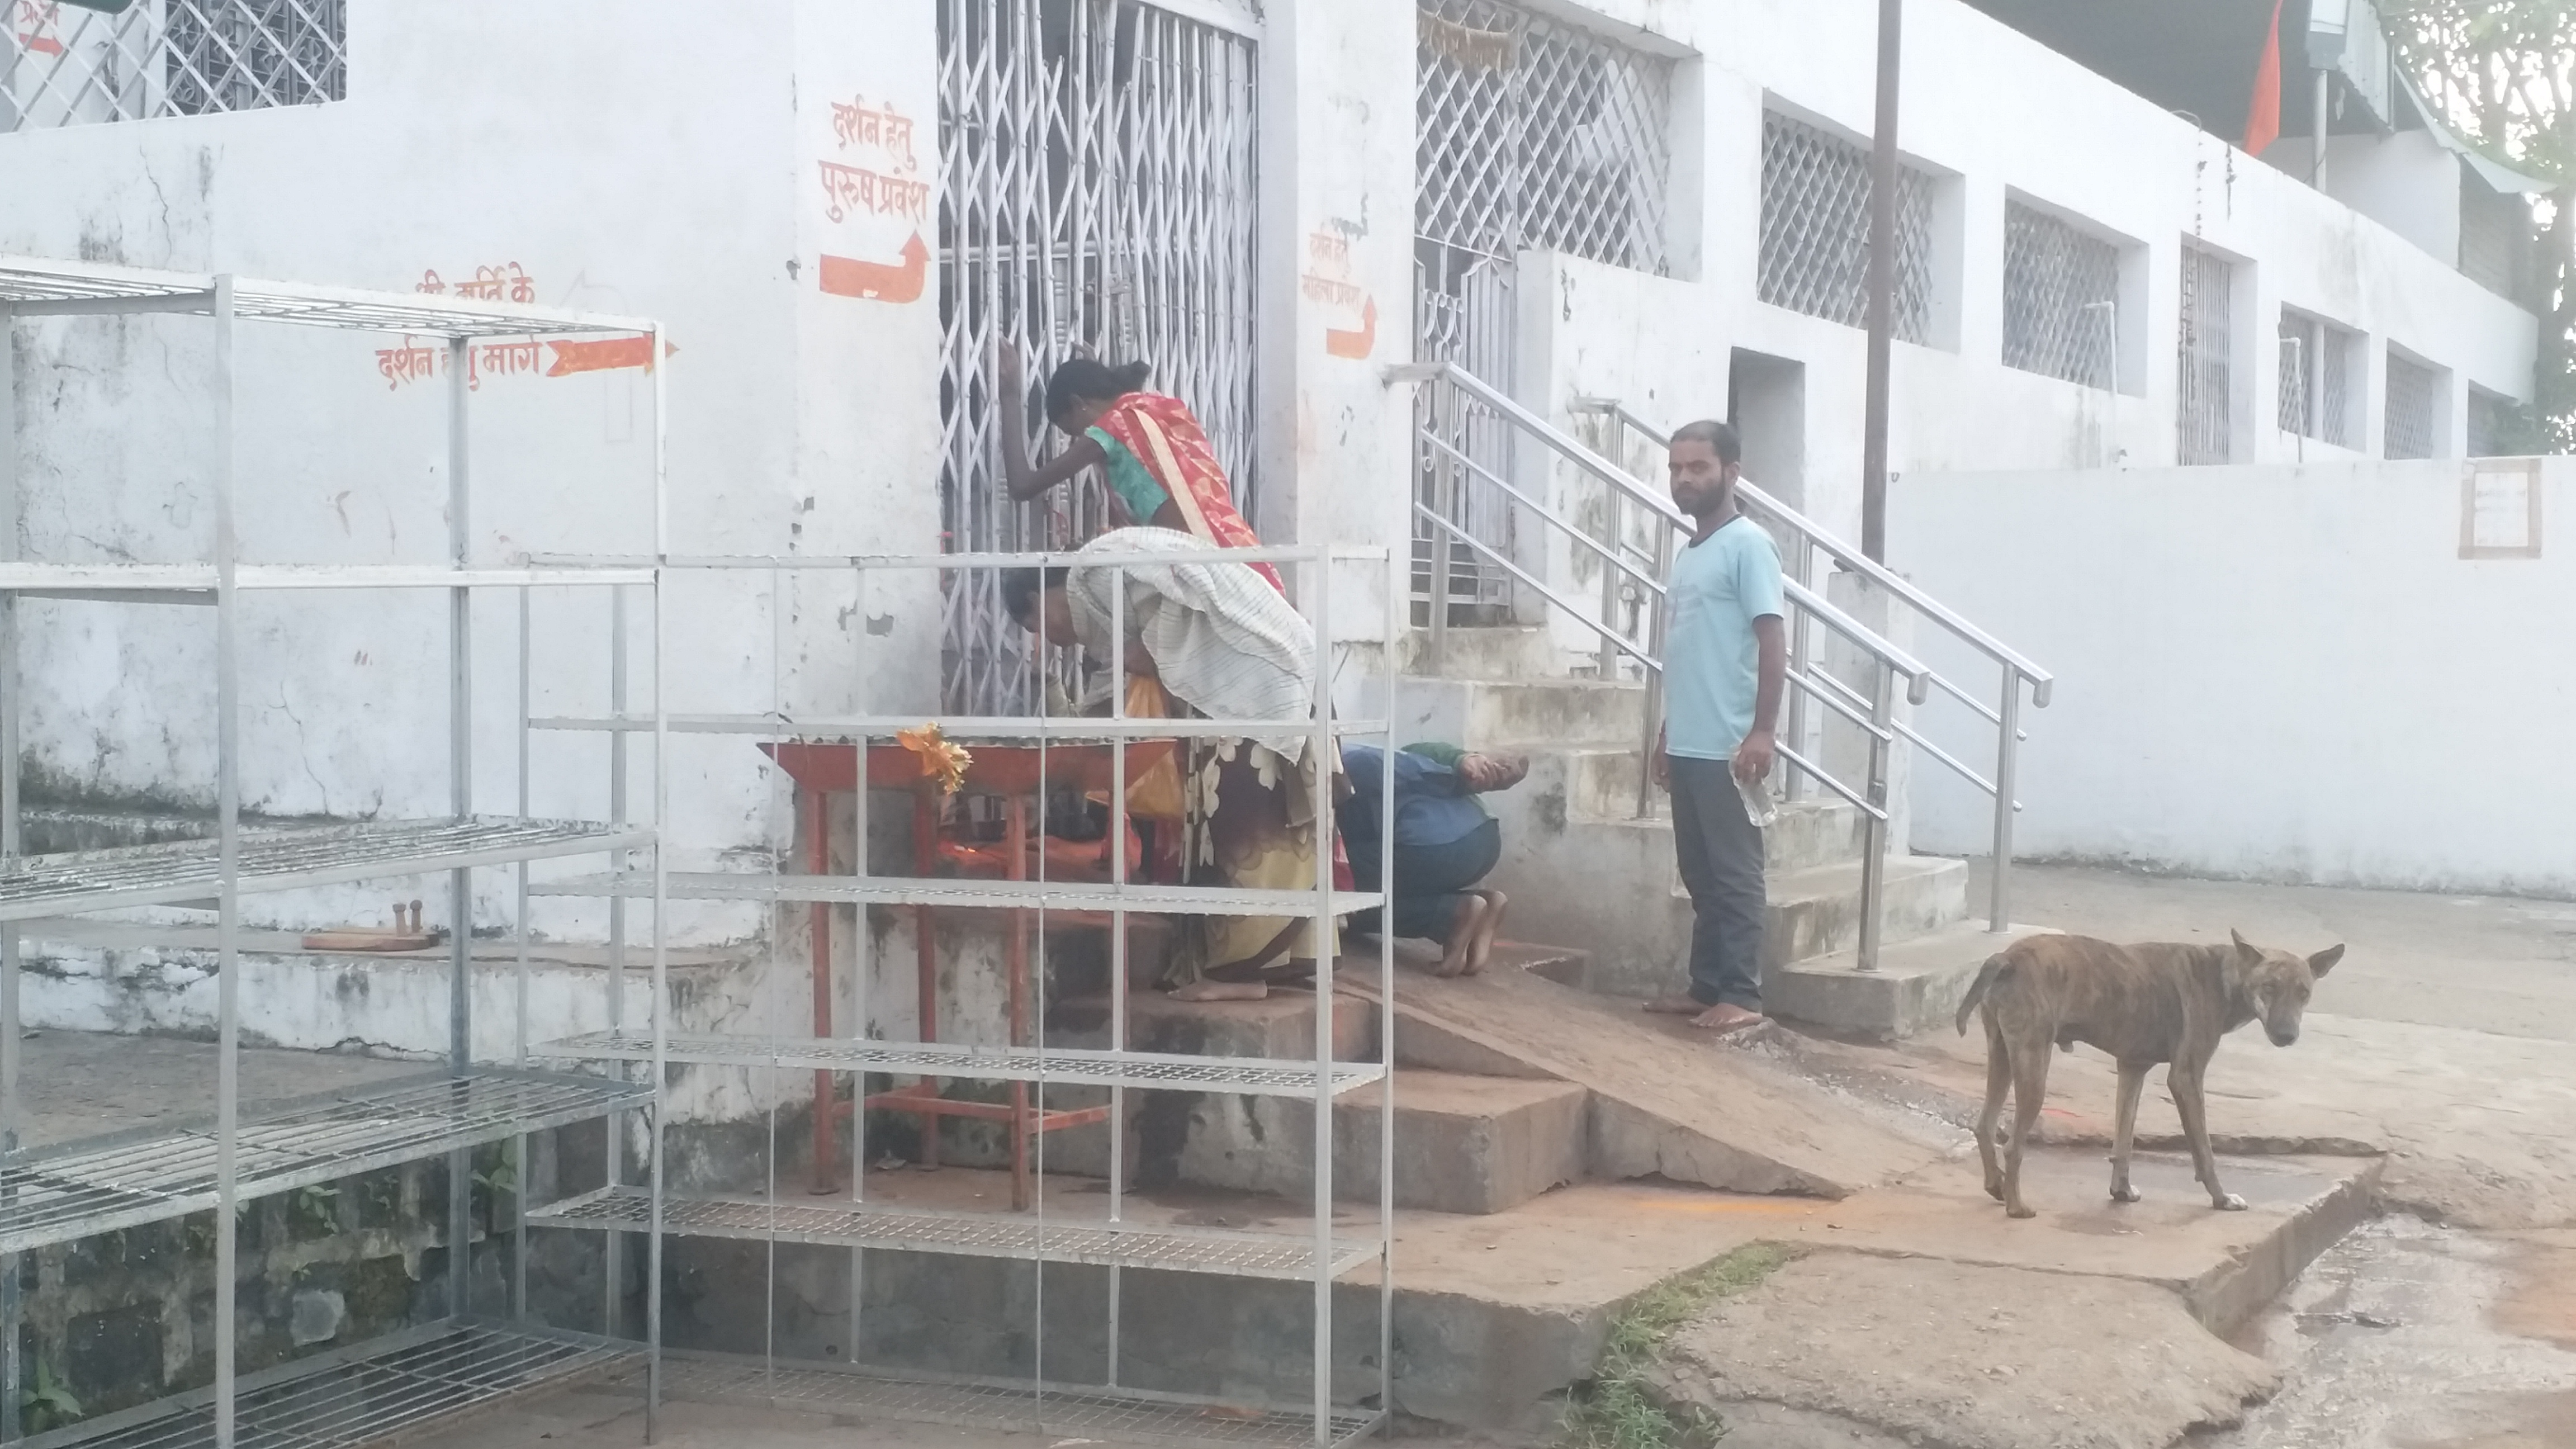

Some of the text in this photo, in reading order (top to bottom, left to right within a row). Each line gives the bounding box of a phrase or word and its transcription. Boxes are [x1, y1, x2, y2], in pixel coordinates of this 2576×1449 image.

[831, 93, 917, 171] दर्शन हेतु
[818, 159, 876, 224] पुरुष
[376, 334, 434, 391] दर्शन
